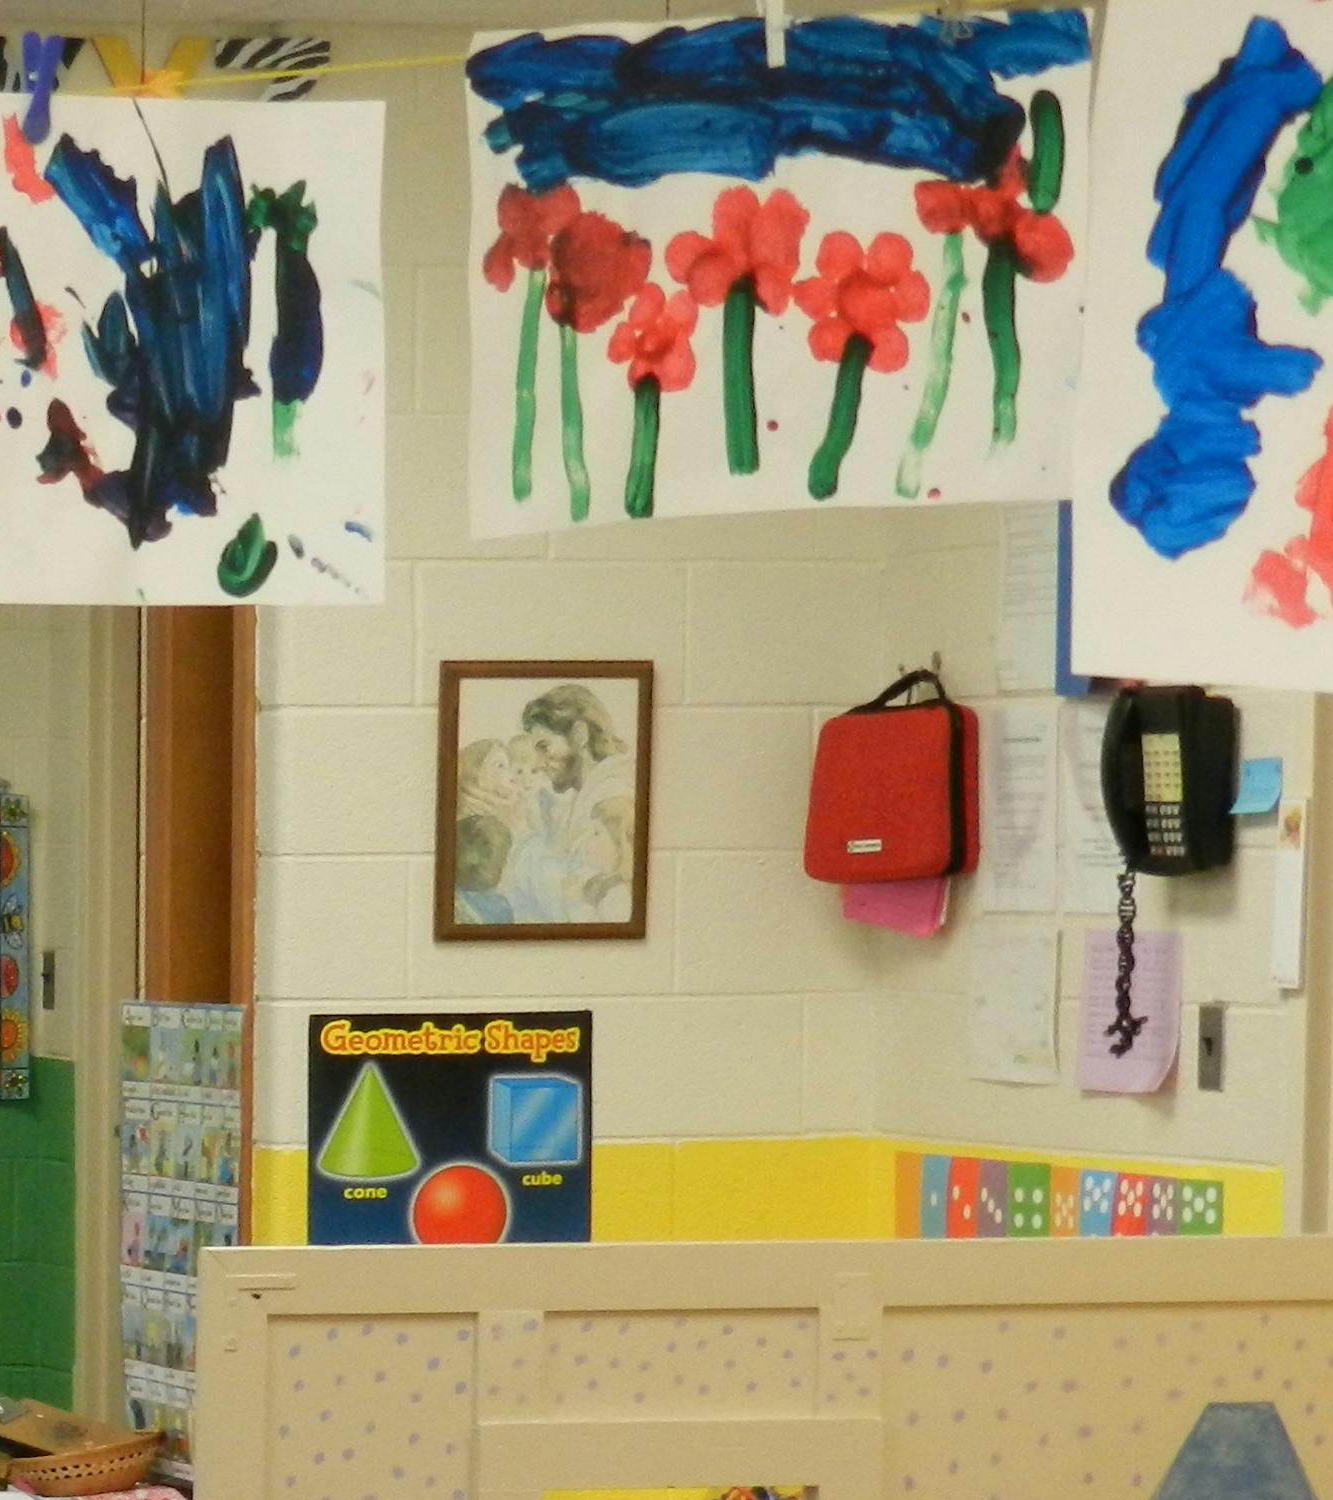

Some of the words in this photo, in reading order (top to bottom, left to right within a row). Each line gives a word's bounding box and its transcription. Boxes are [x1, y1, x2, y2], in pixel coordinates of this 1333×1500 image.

[321, 1019, 482, 1055] Geometric
[483, 1020, 581, 1063] Shapes
[521, 1171, 564, 1186] cube
[343, 1186, 388, 1200] cone
